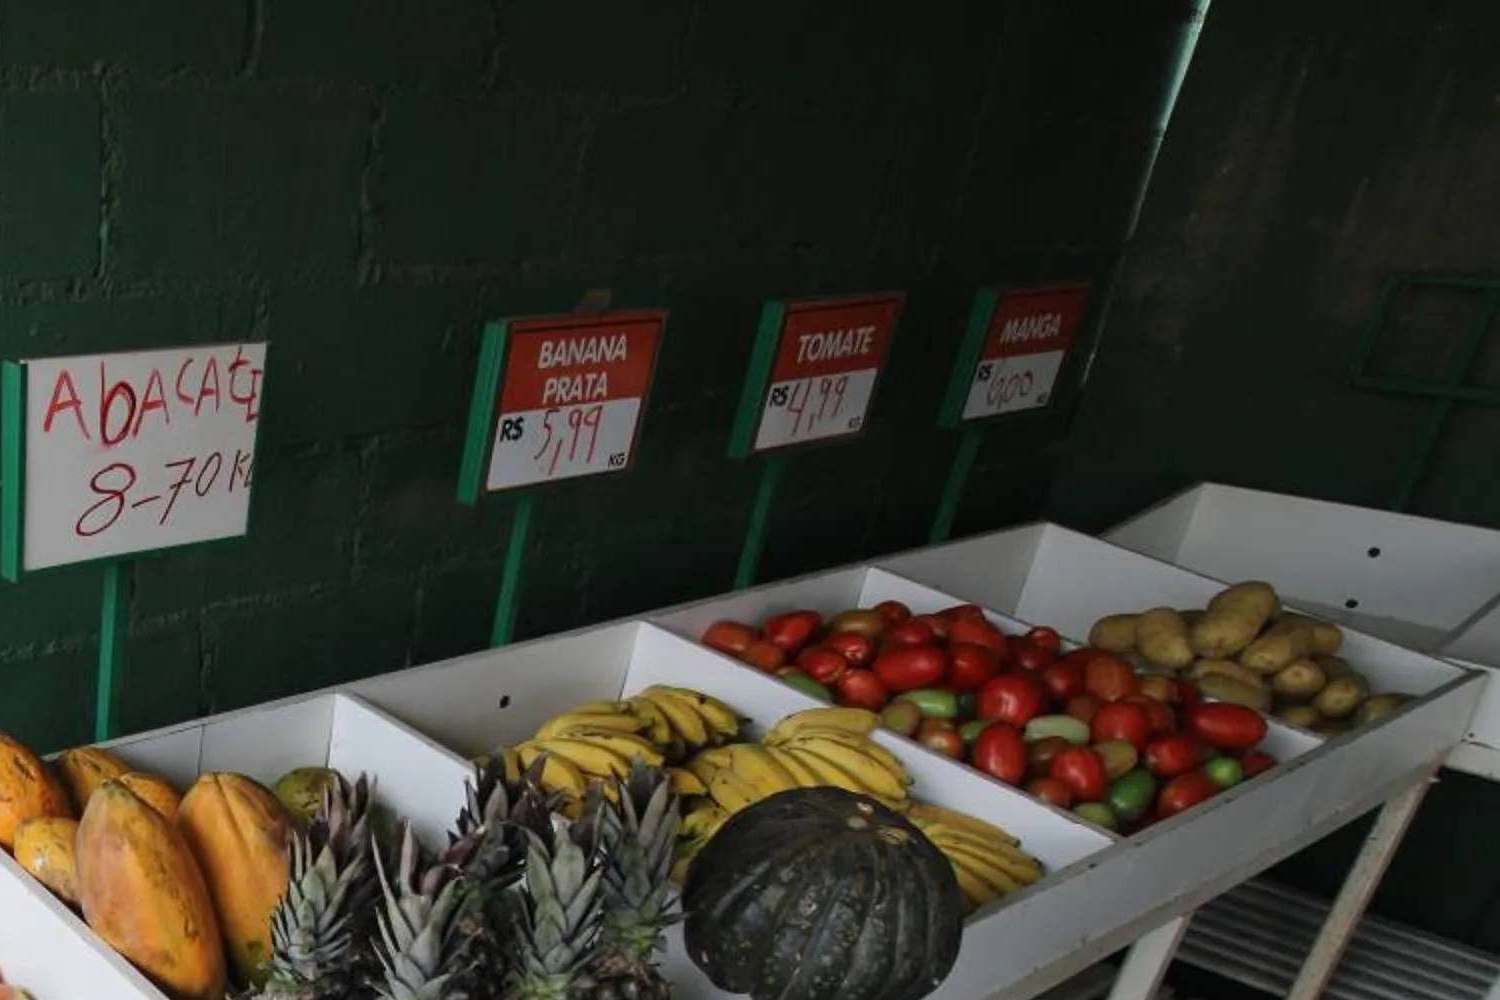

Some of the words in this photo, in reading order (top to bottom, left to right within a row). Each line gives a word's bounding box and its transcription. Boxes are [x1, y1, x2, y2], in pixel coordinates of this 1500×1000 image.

[797, 326, 876, 364] TOMATE
[1000, 313, 1062, 344] MANGA
[537, 334, 628, 369] BANANA
[542, 371, 609, 405] PRATA
[787, 376, 849, 437] 4,99
[534, 405, 603, 476] 5,99
[608, 453, 626, 469] KG
